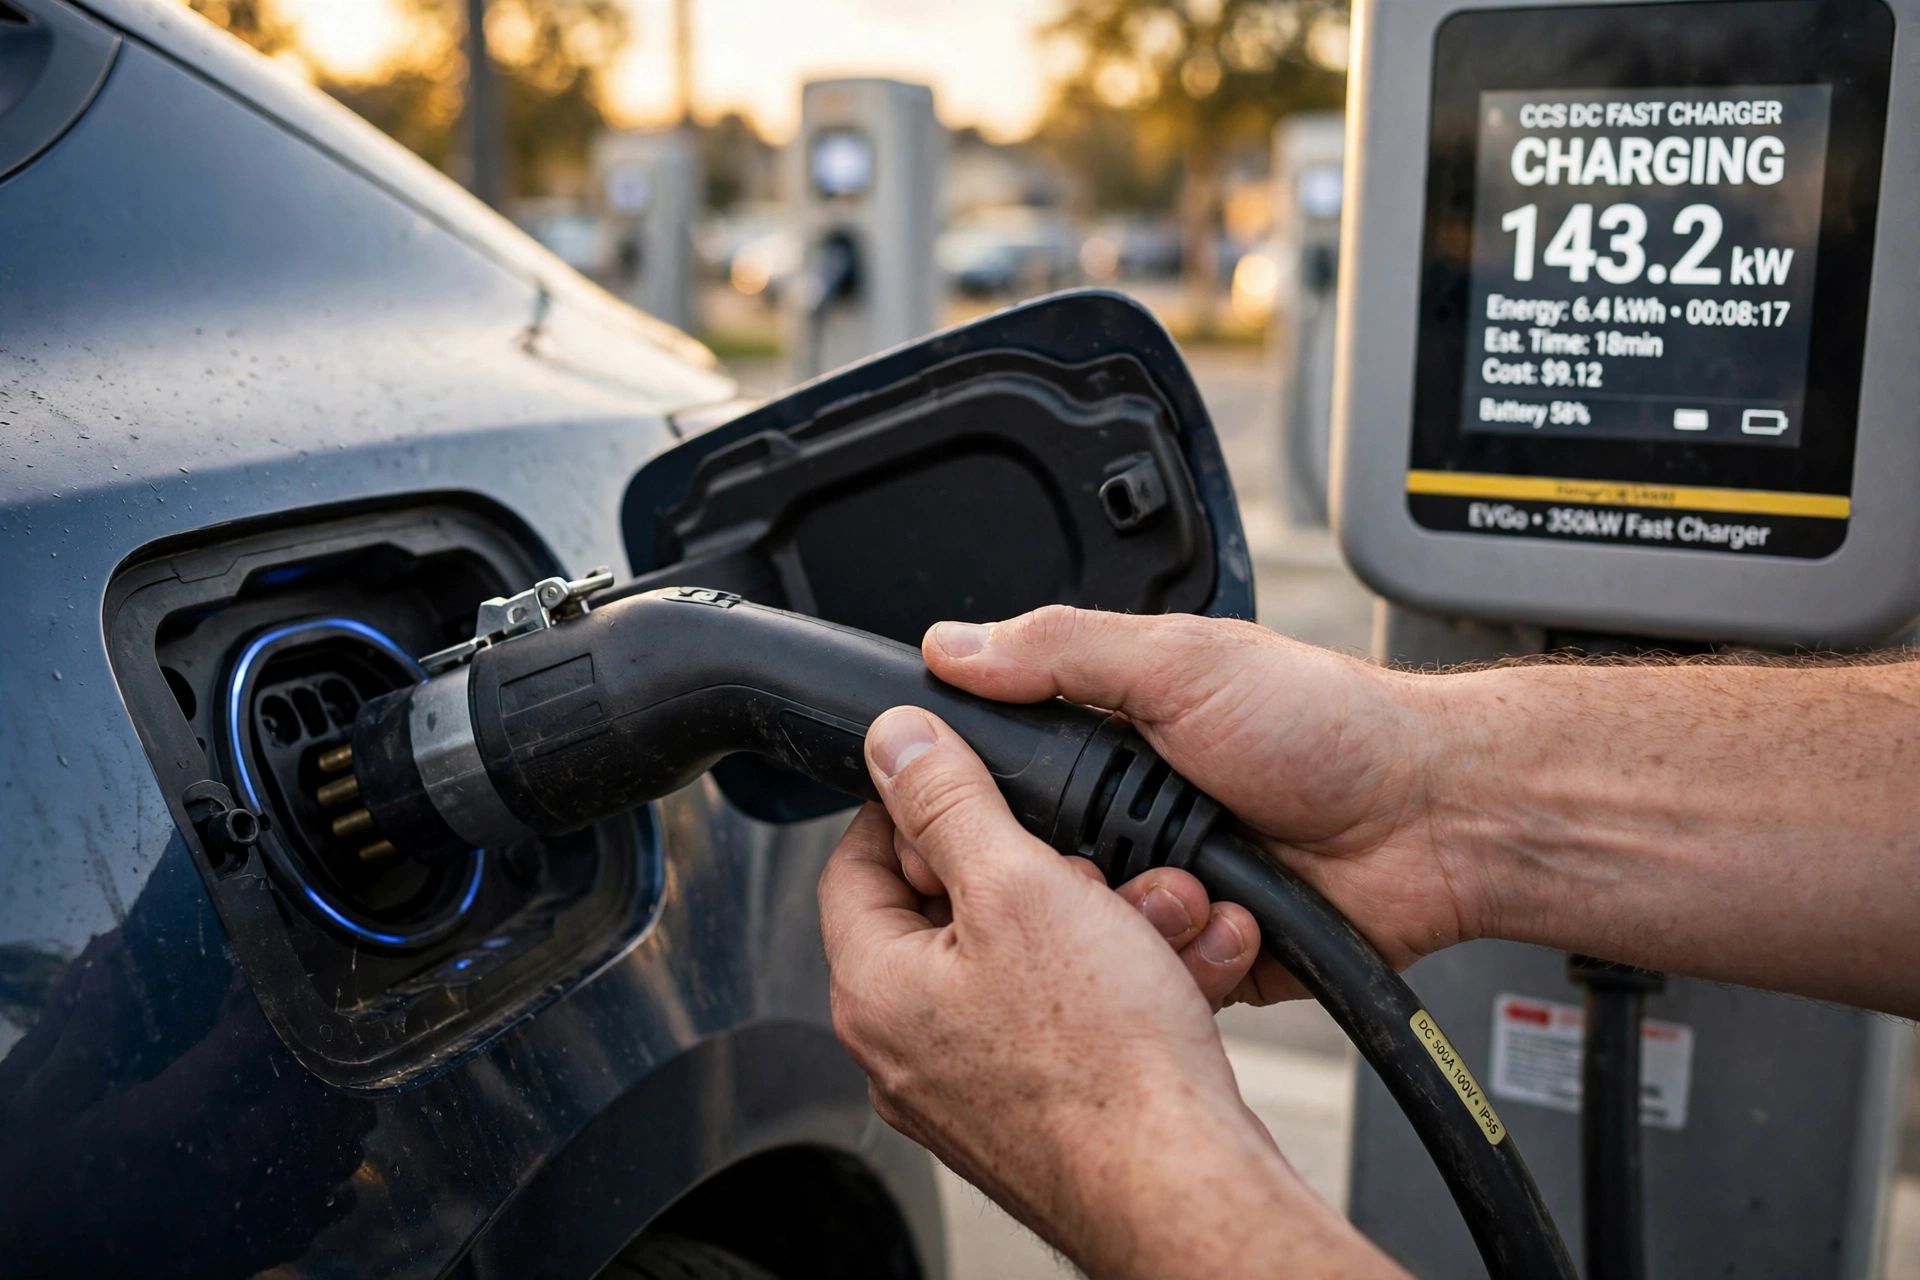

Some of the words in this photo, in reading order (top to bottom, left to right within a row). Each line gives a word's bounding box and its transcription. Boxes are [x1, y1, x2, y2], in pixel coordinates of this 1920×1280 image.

[1520, 103, 1568, 129] CCS
[1569, 103, 1603, 128] DC
[1605, 102, 1664, 127] FAST
[1667, 100, 1783, 126] CHARGER
[1511, 136, 1786, 186] CHARGING
[1502, 203, 1724, 286] 143.2
[1730, 246, 1795, 286] kW
[1486, 293, 1570, 328] Energy:
[1572, 297, 1611, 323] 6.4
[1613, 296, 1667, 324] kWh
[1686, 299, 1791, 327] 00:08:17
[1484, 326, 1525, 354] Est.
[1528, 327, 1591, 356] Time:
[1594, 331, 1664, 358] 18min
[1482, 357, 1539, 386] Cost:
[1541, 358, 1604, 388] $9.12
[1479, 397, 1549, 429] Battery
[1468, 503, 1529, 530] EVGo
[1546, 506, 1623, 537] 350kW
[1625, 512, 1674, 540] Fast
[1676, 516, 1771, 549] Charger
[1418, 1019, 1435, 1040] DC
[1432, 1039, 1455, 1071] 500A
[1453, 1068, 1478, 1099] 100V
